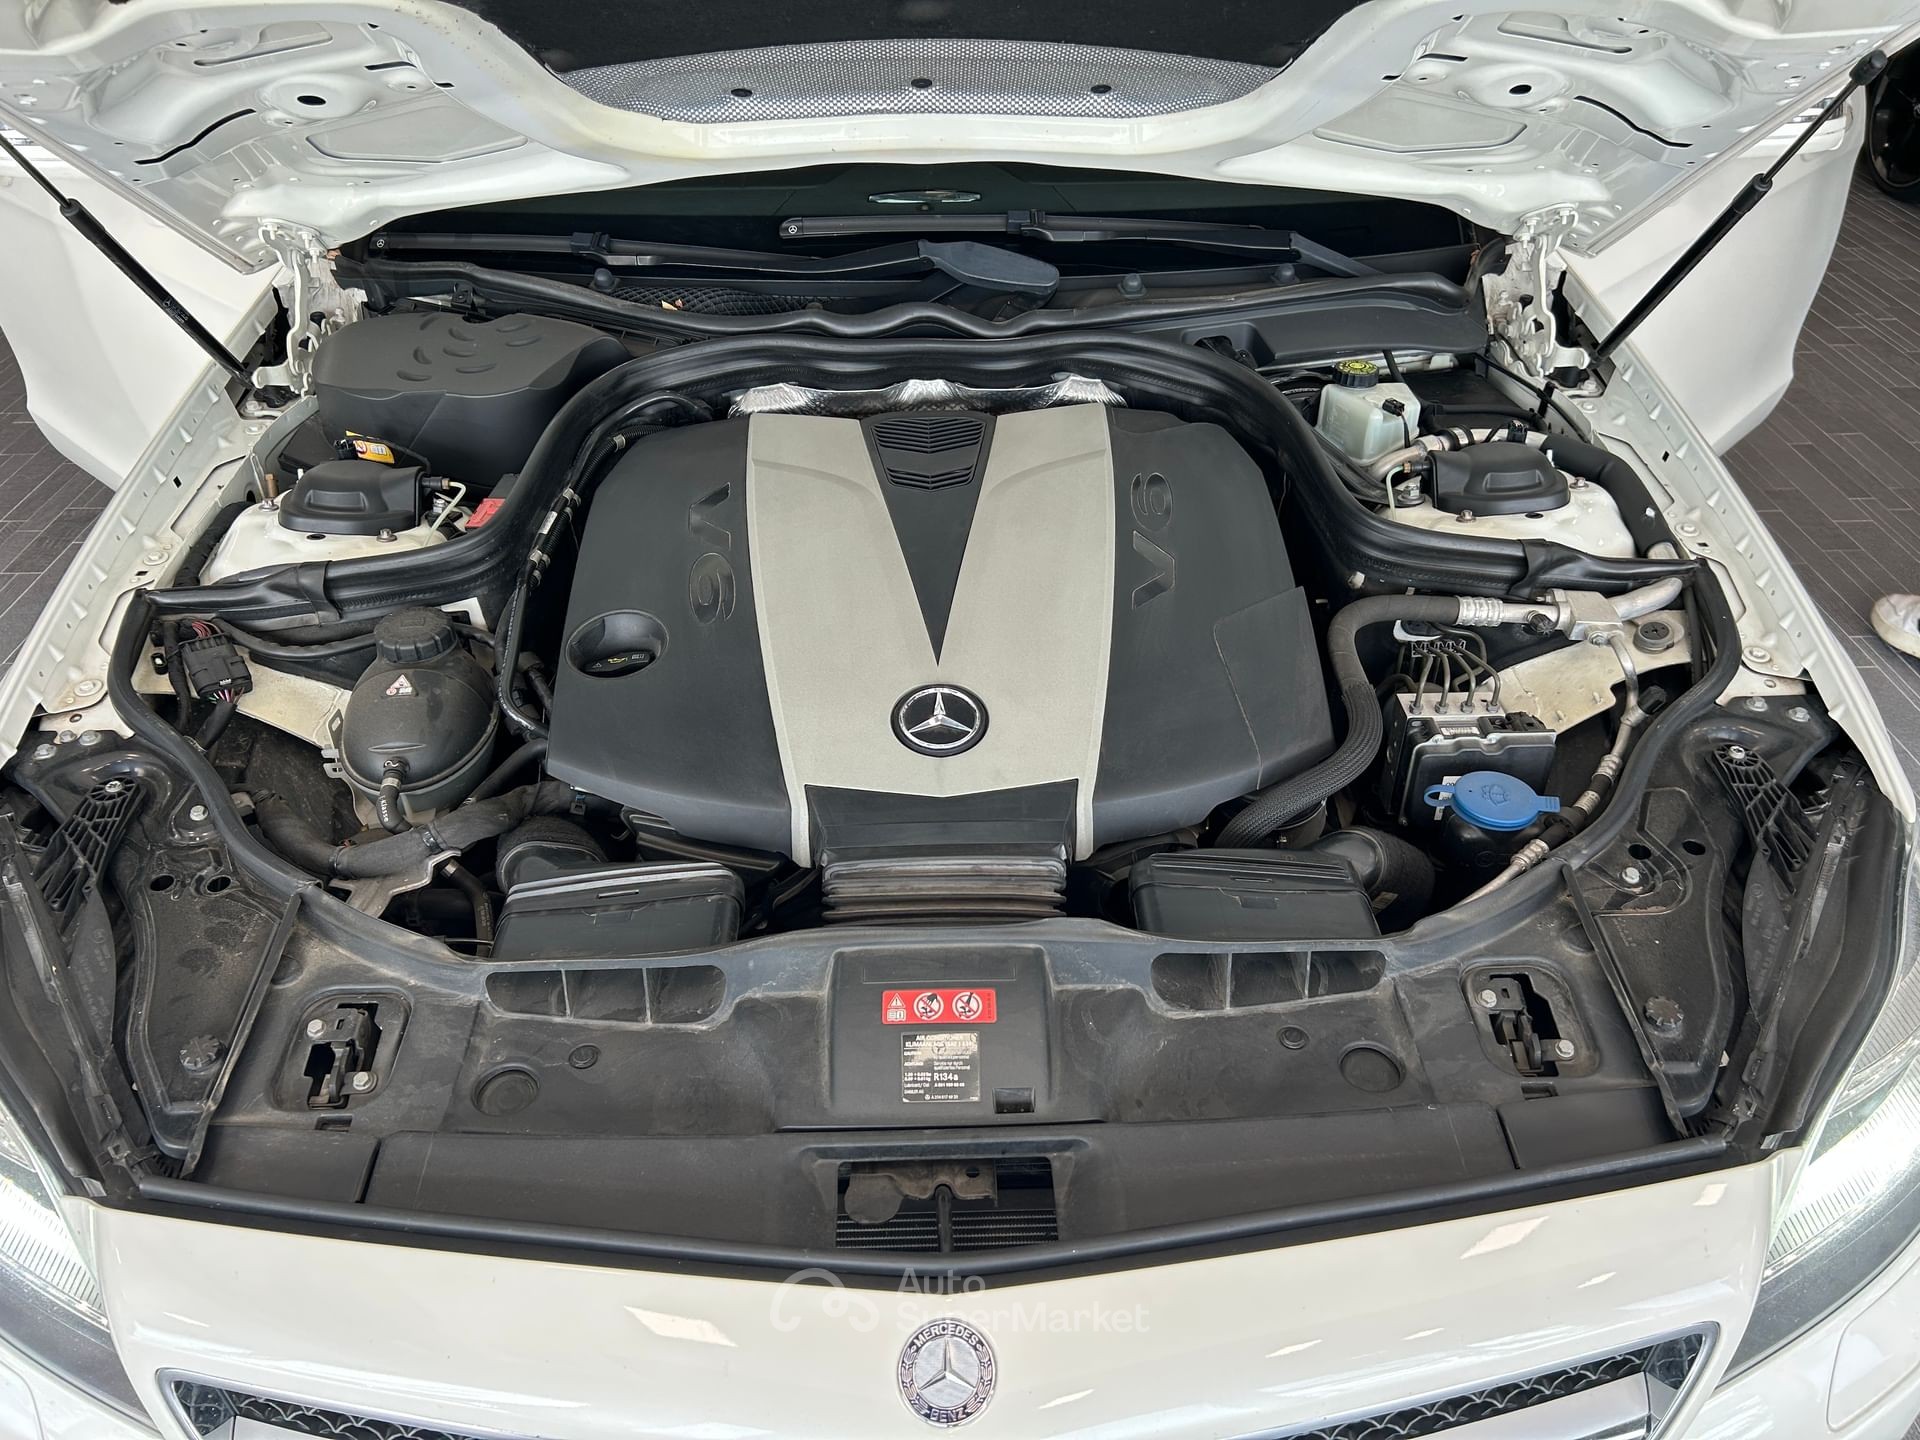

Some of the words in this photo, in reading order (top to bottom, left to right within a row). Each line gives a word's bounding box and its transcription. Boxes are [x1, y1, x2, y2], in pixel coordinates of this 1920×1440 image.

[687, 481, 736, 625] V6
[1131, 471, 1175, 612] V6
[913, 1322, 979, 1348] MERCEDES
[930, 1408, 967, 1422] BENZ
